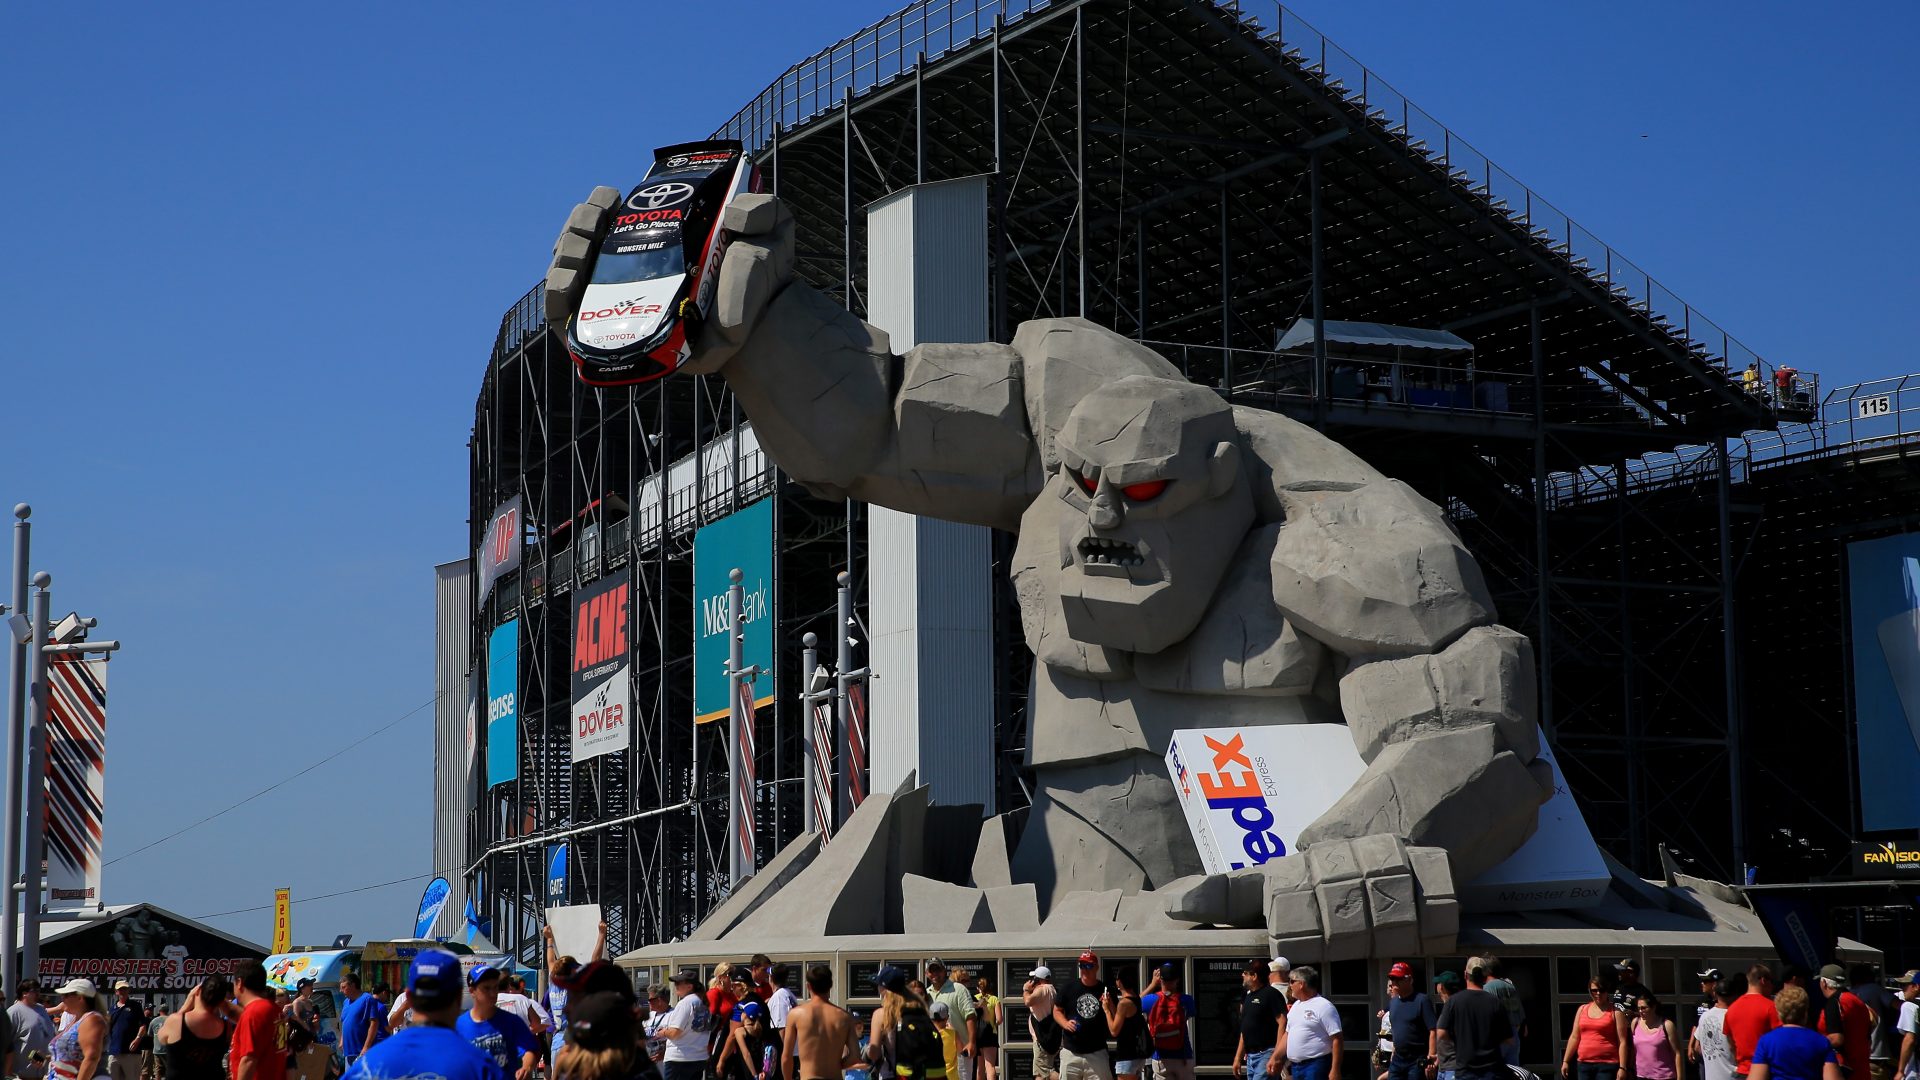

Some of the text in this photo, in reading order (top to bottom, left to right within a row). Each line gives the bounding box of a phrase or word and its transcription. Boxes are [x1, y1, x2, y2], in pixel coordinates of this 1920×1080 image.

[690, 153, 732, 161] TOYOTA
[616, 209, 682, 225] TOYOTA
[614, 221, 680, 234] Let's Go Places
[616, 241, 664, 254] MONSTER MILE
[707, 225, 728, 278] TOYO
[580, 304, 662, 321] DOVER
[605, 333, 636, 341] TOYOTA
[598, 363, 635, 372] CAMRY
[1861, 398, 1888, 415] 115
[573, 582, 629, 672] ACME
[578, 703, 625, 739] DOVER
[1169, 739, 1191, 801] FedEx
[1255, 756, 1277, 797] Express
[1197, 732, 1287, 871] edEx
[1196, 819, 1220, 875] Monste
[1863, 842, 1920, 865] FANVISIO
[550, 878, 563, 896] GATE
[1499, 887, 1600, 902] Monster Box
[39, 958, 245, 975] HE MONSTER'S CLOSE
[107, 976, 160, 989] TRACK
